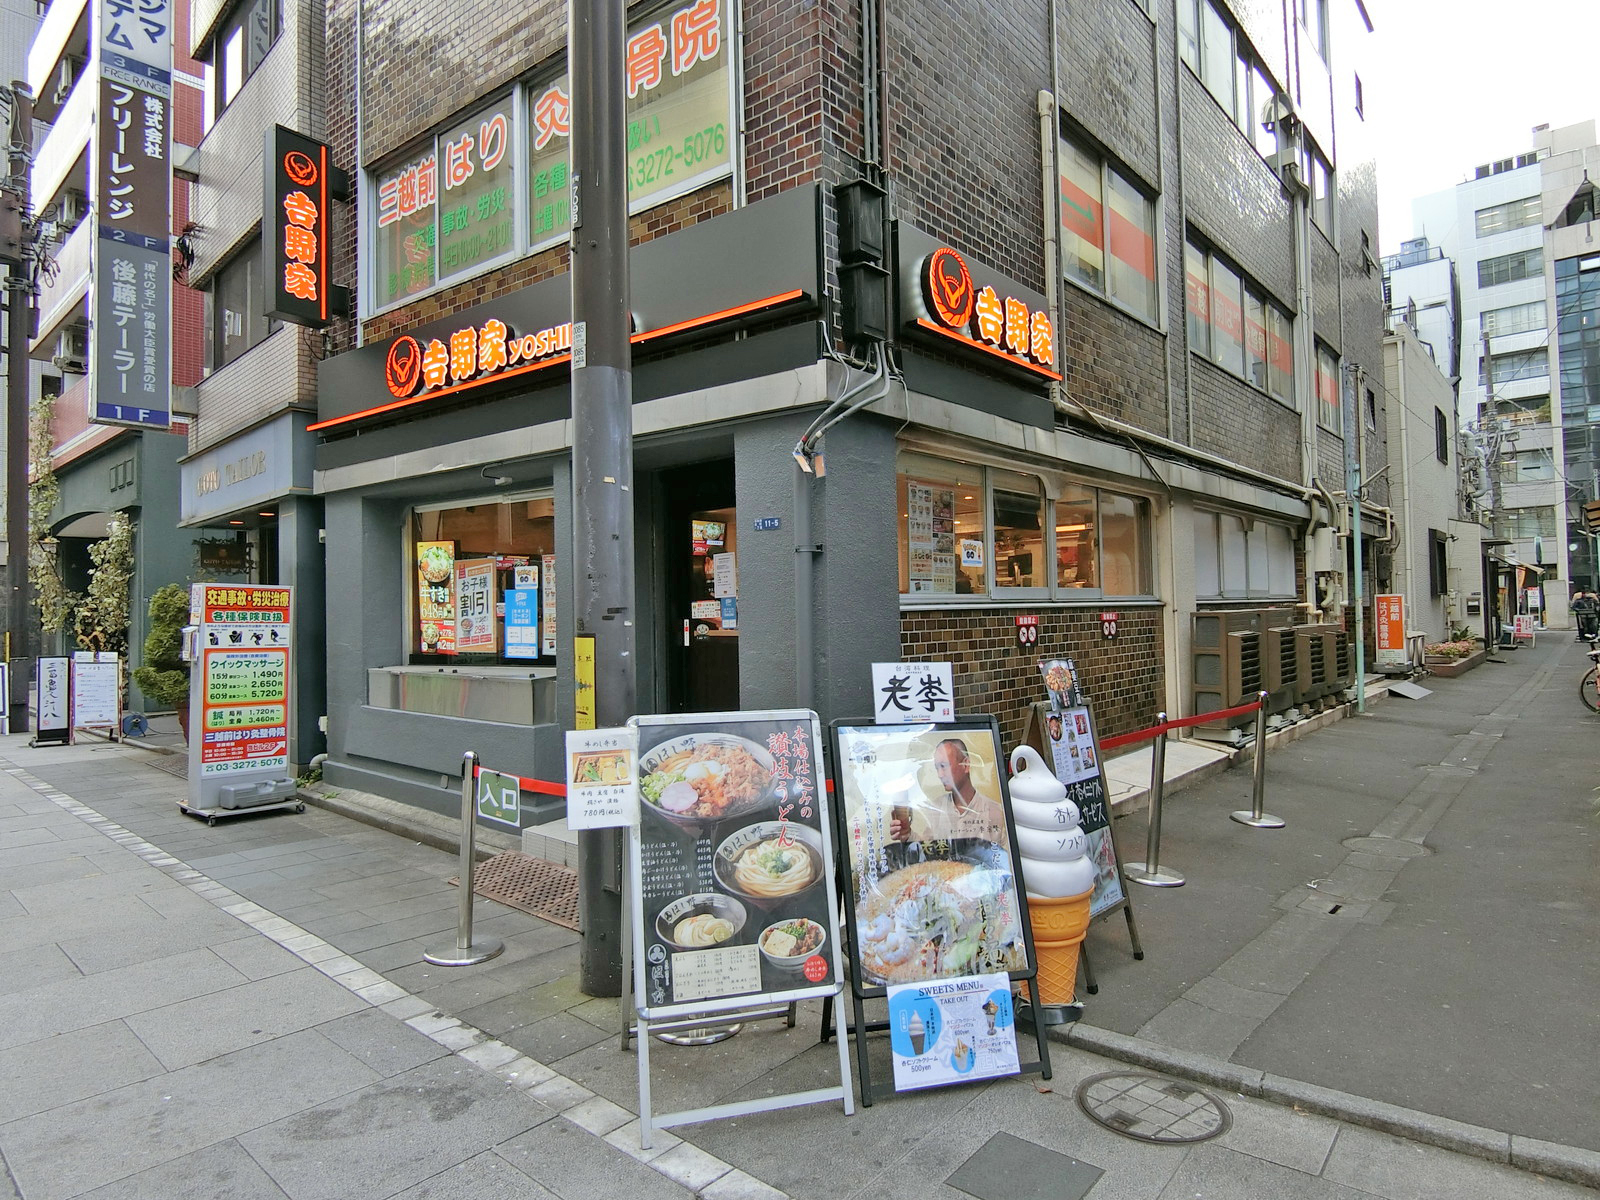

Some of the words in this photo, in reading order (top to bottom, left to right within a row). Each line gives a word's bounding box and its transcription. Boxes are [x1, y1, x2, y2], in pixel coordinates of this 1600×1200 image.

[104, 66, 130, 82] FREE
[132, 76, 169, 96] RANGE
[378, 154, 435, 228] 三越前
[445, 113, 508, 190] はり
[627, 0, 721, 99] 骨院
[144, 95, 164, 160] 株式会社
[109, 83, 136, 221] フリーレンジ
[534, 161, 567, 199] 各種
[284, 191, 318, 301] 吉野家
[111, 258, 137, 394] 後藤テーラー
[976, 285, 1053, 366] 吉野家
[422, 318, 508, 390] 吉野家
[764, 519, 779, 528] 11-5
[461, 575, 488, 592] お子様
[207, 589, 290, 607] 交通事故・労災治療
[460, 589, 489, 618] 割引
[1390, 597, 1400, 621] 三越前
[213, 611, 283, 622] 各種保険取扱
[210, 659, 285, 669] クイックマッサージ
[204, 727, 286, 743] 三越前はり灸整骨院
[215, 758, 283, 771] 03-3272-5076
[792, 725, 814, 818] 本場仕込みの
[480, 783, 517, 810] 入口
[766, 731, 795, 847] 讃岐うどん
[584, 808, 623, 817] 780円(税込)
[1054, 806, 1076, 824] 杏仁
[918, 984, 955, 997] SWEETS
[956, 981, 979, 992] MENU
[940, 997, 955, 1006] TAKE
[956, 995, 969, 1003] OUT
[901, 1056, 939, 1067] 杏仁ソフトクリーム
[911, 1064, 932, 1073] 500yen
